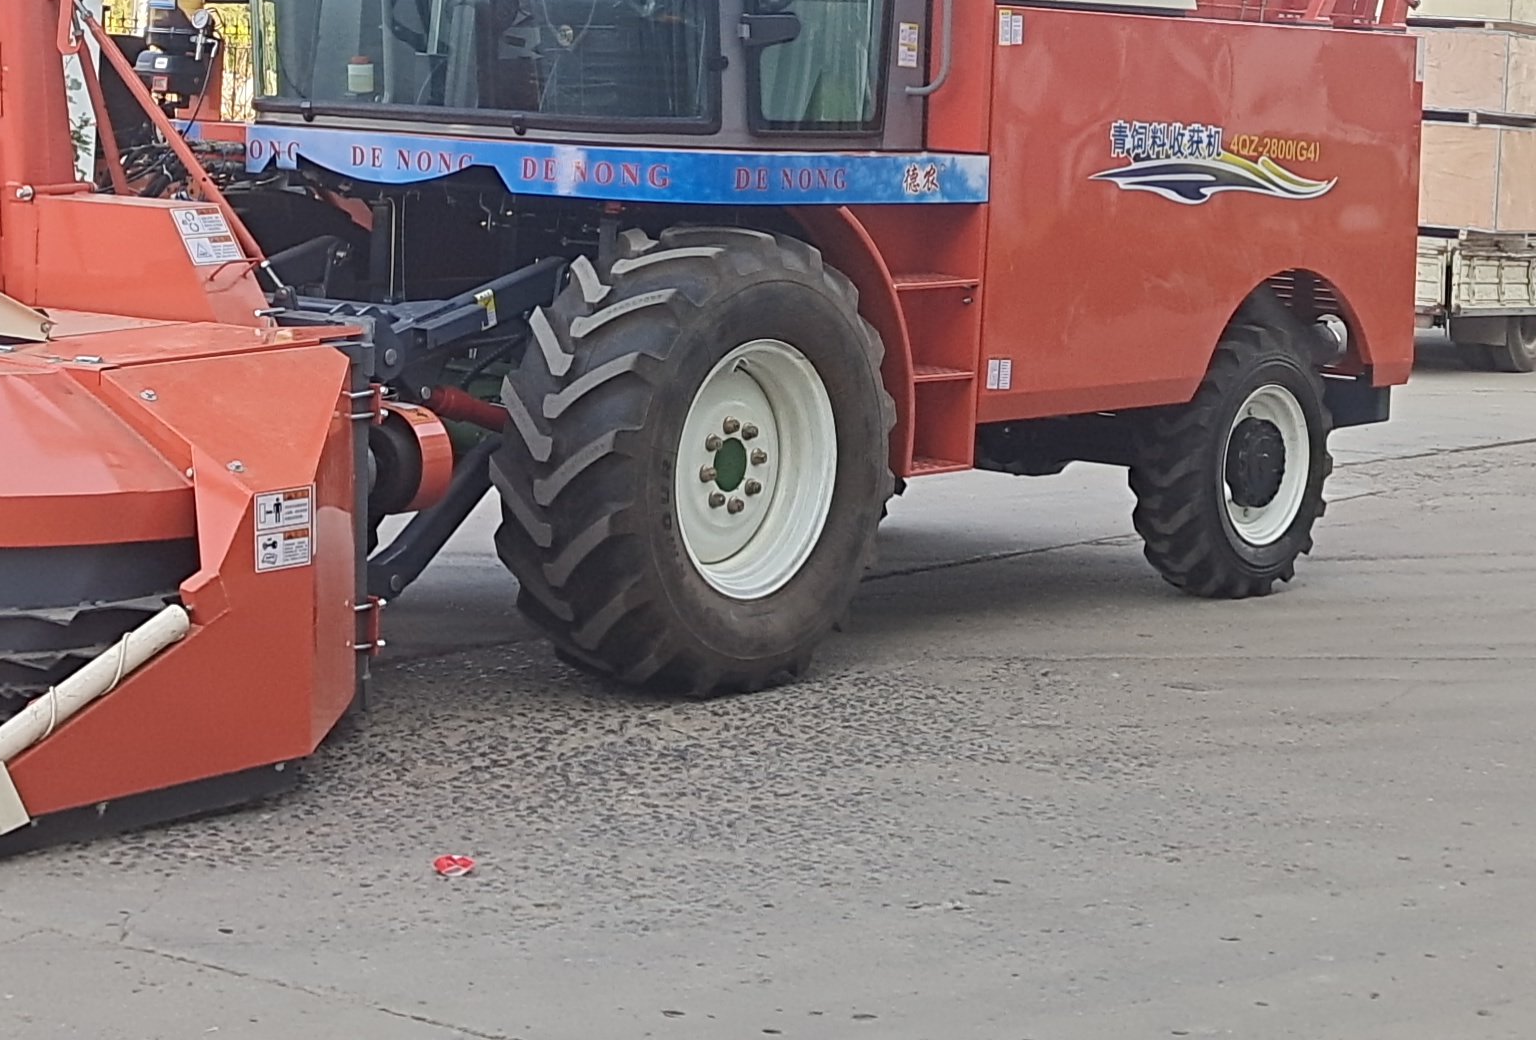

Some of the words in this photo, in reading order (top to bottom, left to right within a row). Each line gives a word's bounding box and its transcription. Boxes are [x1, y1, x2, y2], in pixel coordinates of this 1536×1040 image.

[1111, 121, 1223, 158] 青饲料收获机
[1230, 134, 1320, 161] 4QZ-2800(G4)
[352, 145, 383, 168] DE
[522, 157, 556, 181] DE
[573, 160, 670, 188] NONG
[735, 168, 768, 190] DE
[781, 168, 847, 190] NONG
